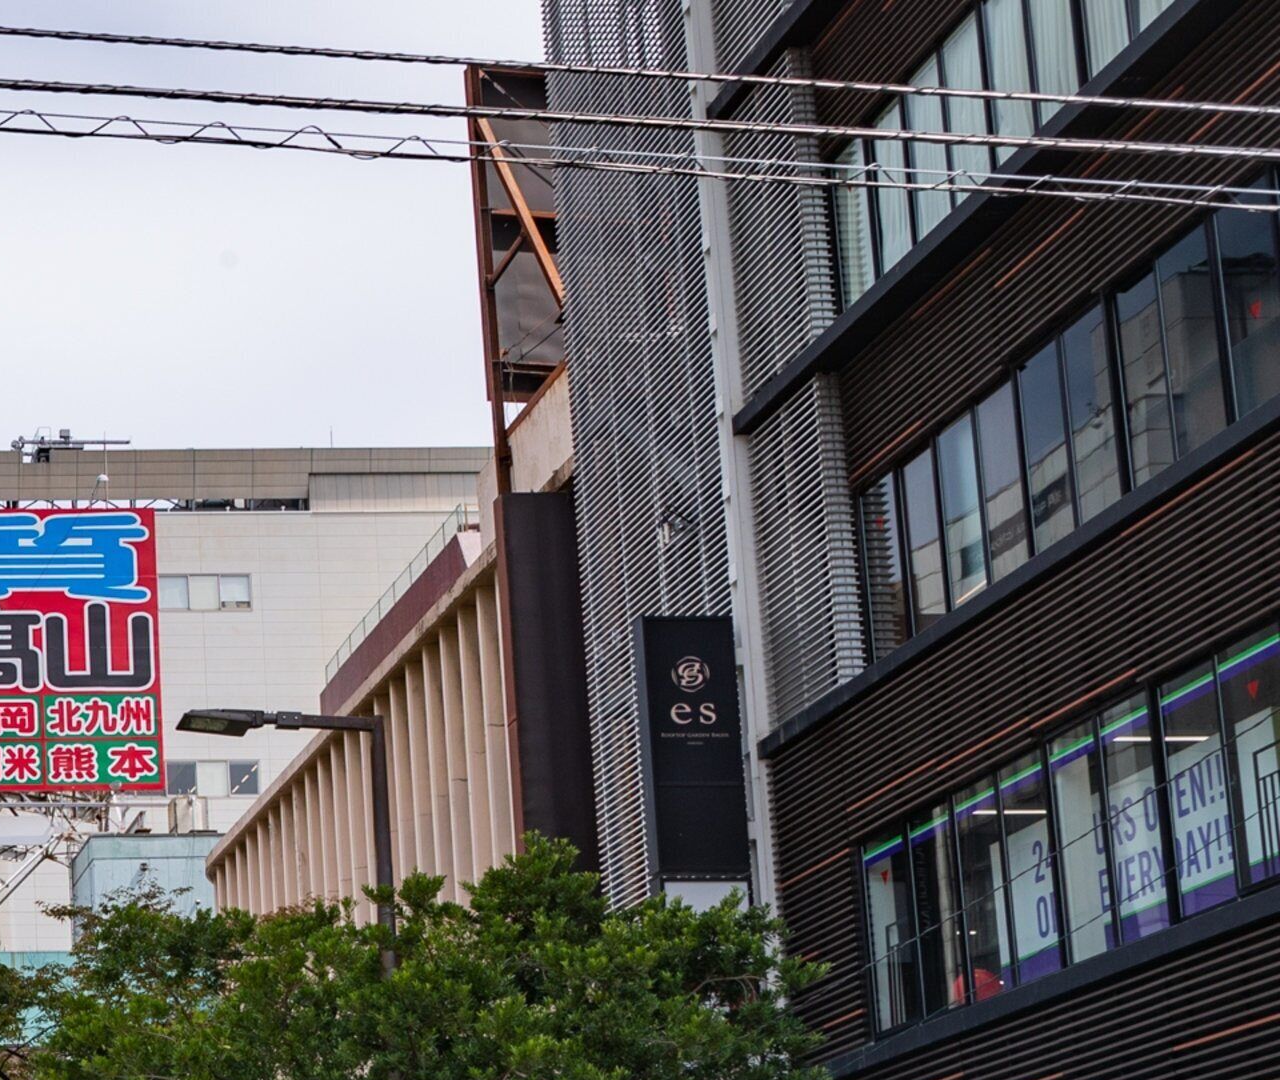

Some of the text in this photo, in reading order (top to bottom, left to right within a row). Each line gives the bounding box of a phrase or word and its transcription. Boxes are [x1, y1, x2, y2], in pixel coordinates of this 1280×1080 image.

[47, 697, 156, 736] 北九州
[48, 744, 157, 783] 熊本
[1143, 753, 1225, 833] OEN!!
